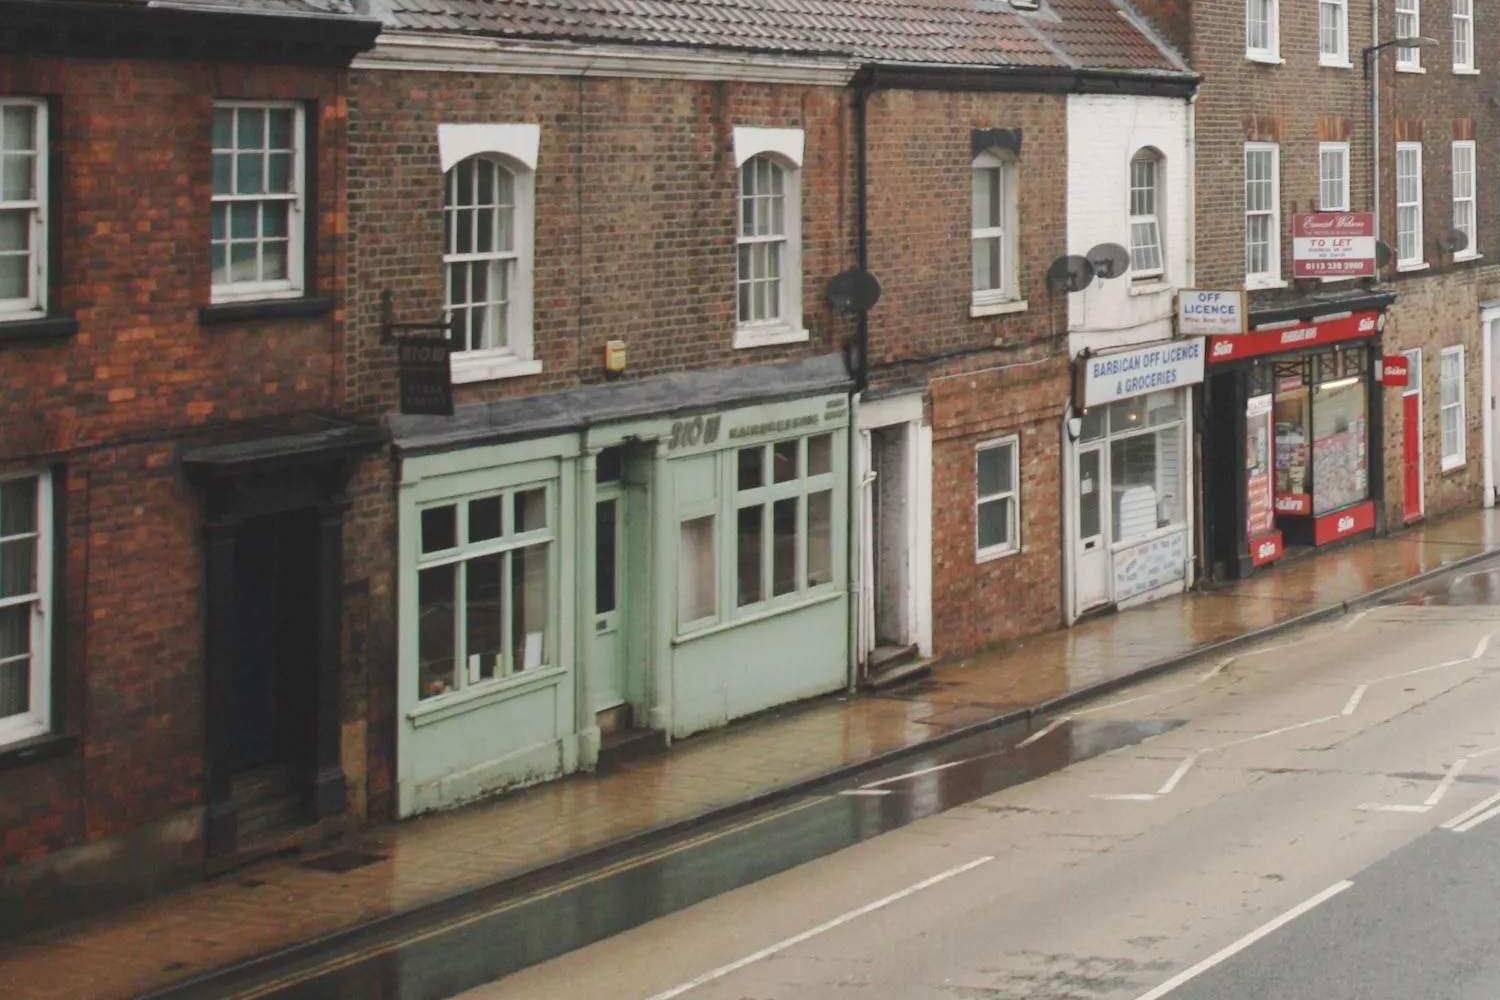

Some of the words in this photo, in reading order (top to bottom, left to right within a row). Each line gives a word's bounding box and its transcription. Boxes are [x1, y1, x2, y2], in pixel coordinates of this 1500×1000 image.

[1310, 238, 1326, 247] TO
[1333, 238, 1353, 247] LET
[1198, 292, 1221, 302] OFF
[1184, 304, 1236, 315] LICENCE
[1093, 355, 1141, 378] BARBICAN
[1143, 352, 1160, 368] OFF
[1162, 344, 1199, 364] LICENCE
[1116, 381, 1122, 394] &
[1125, 369, 1177, 392] GROCERIES
[1276, 497, 1303, 511] un
